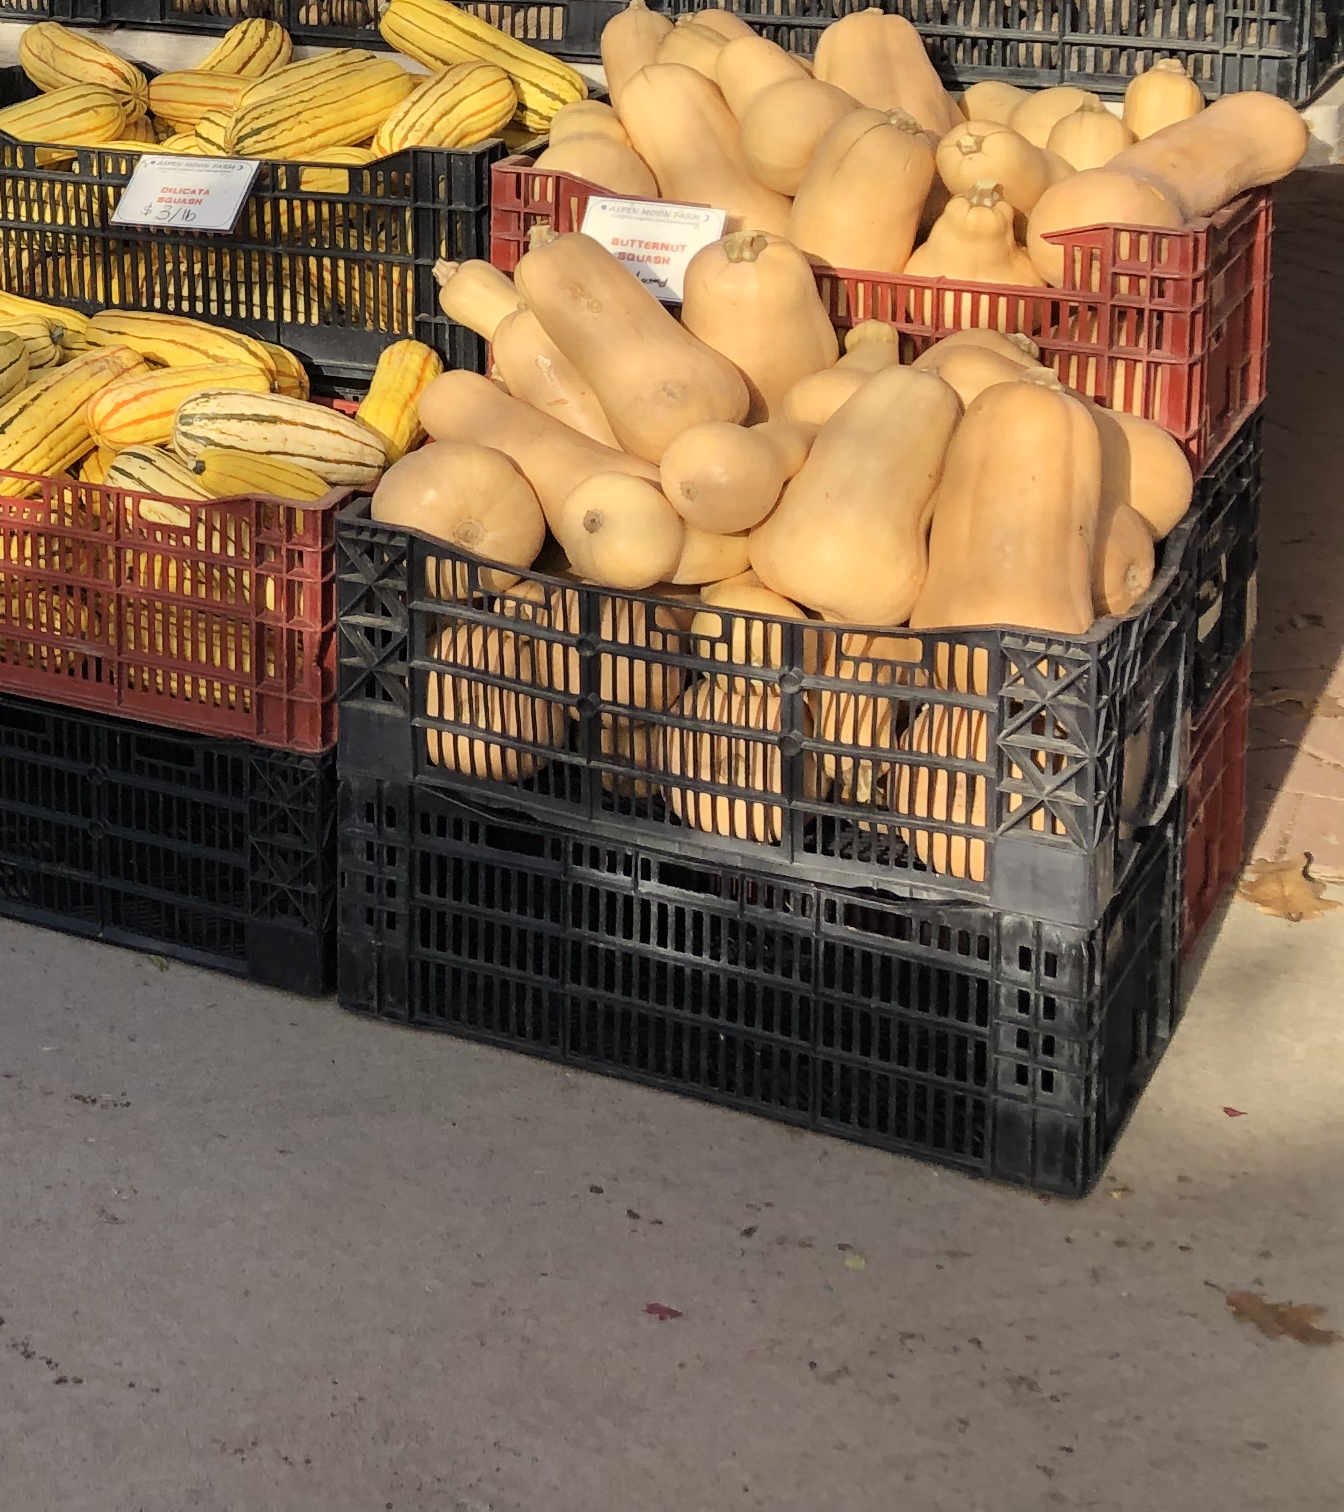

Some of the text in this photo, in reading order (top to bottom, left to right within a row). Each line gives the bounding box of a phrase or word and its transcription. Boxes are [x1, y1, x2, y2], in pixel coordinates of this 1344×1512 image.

[156, 196, 204, 206] SQUASH
[611, 237, 687, 253] BUTTERNUT
[617, 251, 671, 266] SQUASH
